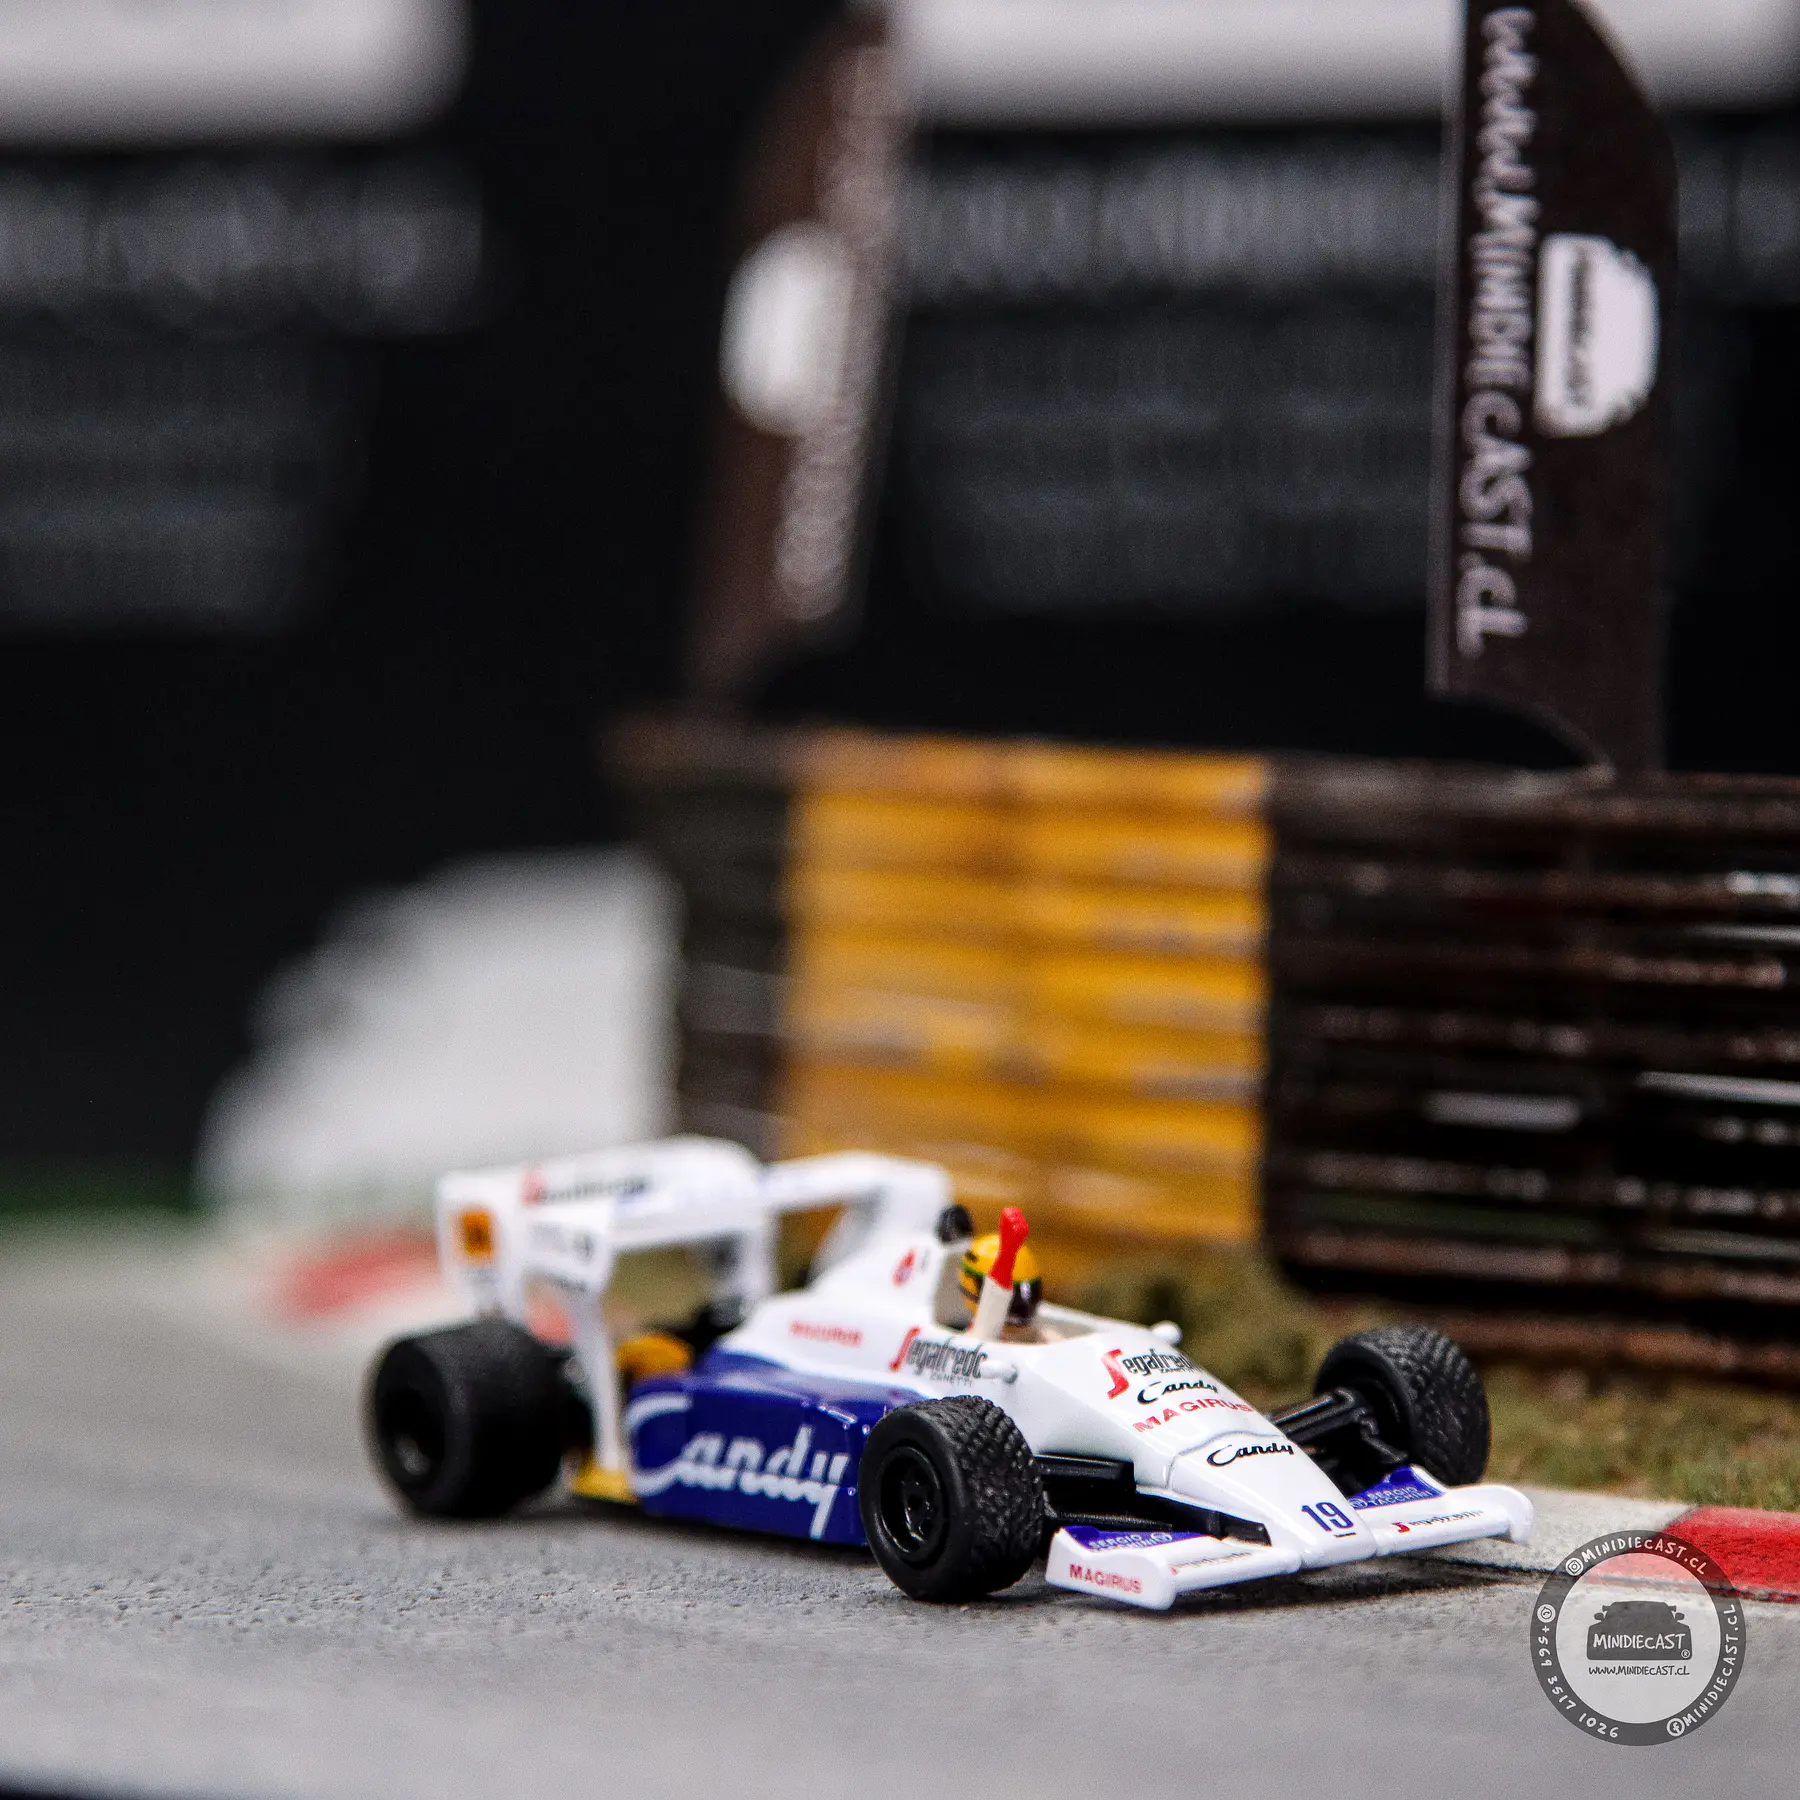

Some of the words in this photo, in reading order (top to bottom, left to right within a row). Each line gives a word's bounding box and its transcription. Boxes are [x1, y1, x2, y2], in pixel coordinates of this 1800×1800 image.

[1137, 1379, 1219, 1405] Candy
[1132, 1397, 1254, 1433] MAGIRUS
[623, 1392, 849, 1540] Candy
[1206, 1442, 1294, 1468] Candy
[1301, 1501, 1355, 1533] 19
[1088, 1533, 1143, 1550] SERGIO
[1069, 1563, 1142, 1594] MAGIRUS
